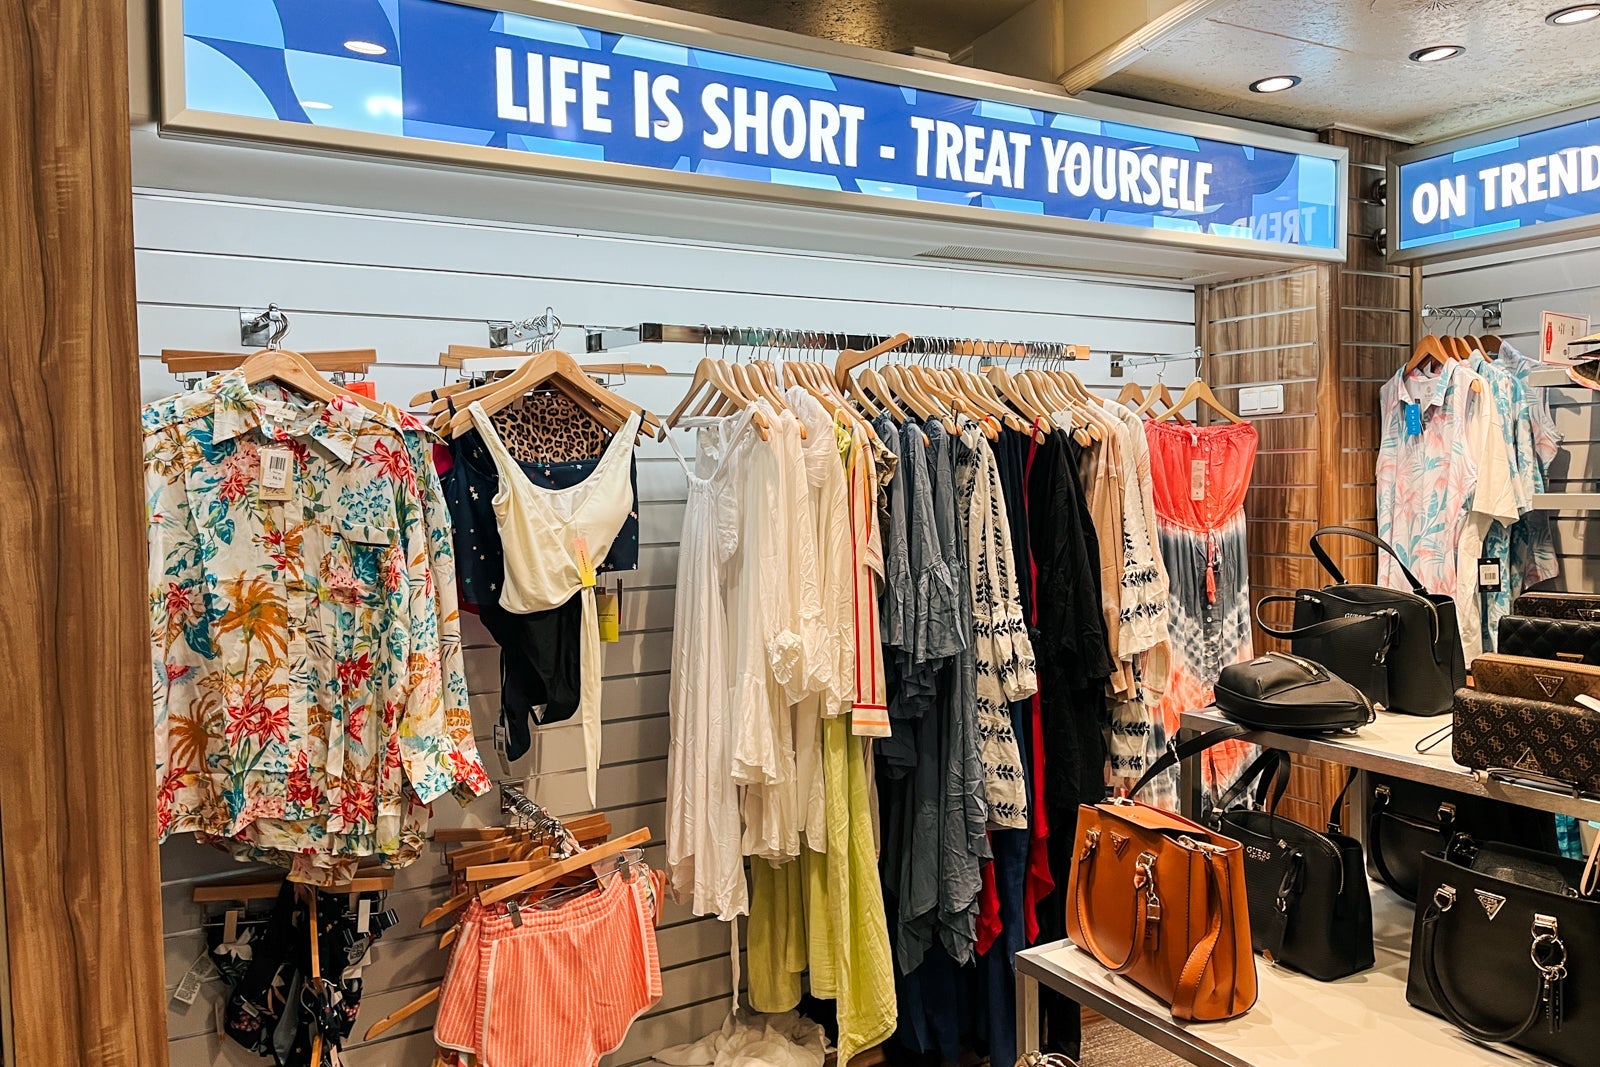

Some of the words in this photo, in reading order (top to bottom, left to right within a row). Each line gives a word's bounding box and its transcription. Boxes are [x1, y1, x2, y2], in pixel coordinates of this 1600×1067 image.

[495, 46, 613, 133] LIFE
[633, 69, 684, 142] IS
[701, 82, 865, 167] SHORT
[879, 145, 895, 159] -
[910, 116, 1031, 189] TREAT
[1041, 136, 1213, 212] YOURSELF
[1412, 175, 1466, 224] ON
[1478, 145, 1600, 212] TREND
[1246, 845, 1271, 860] GUESS
